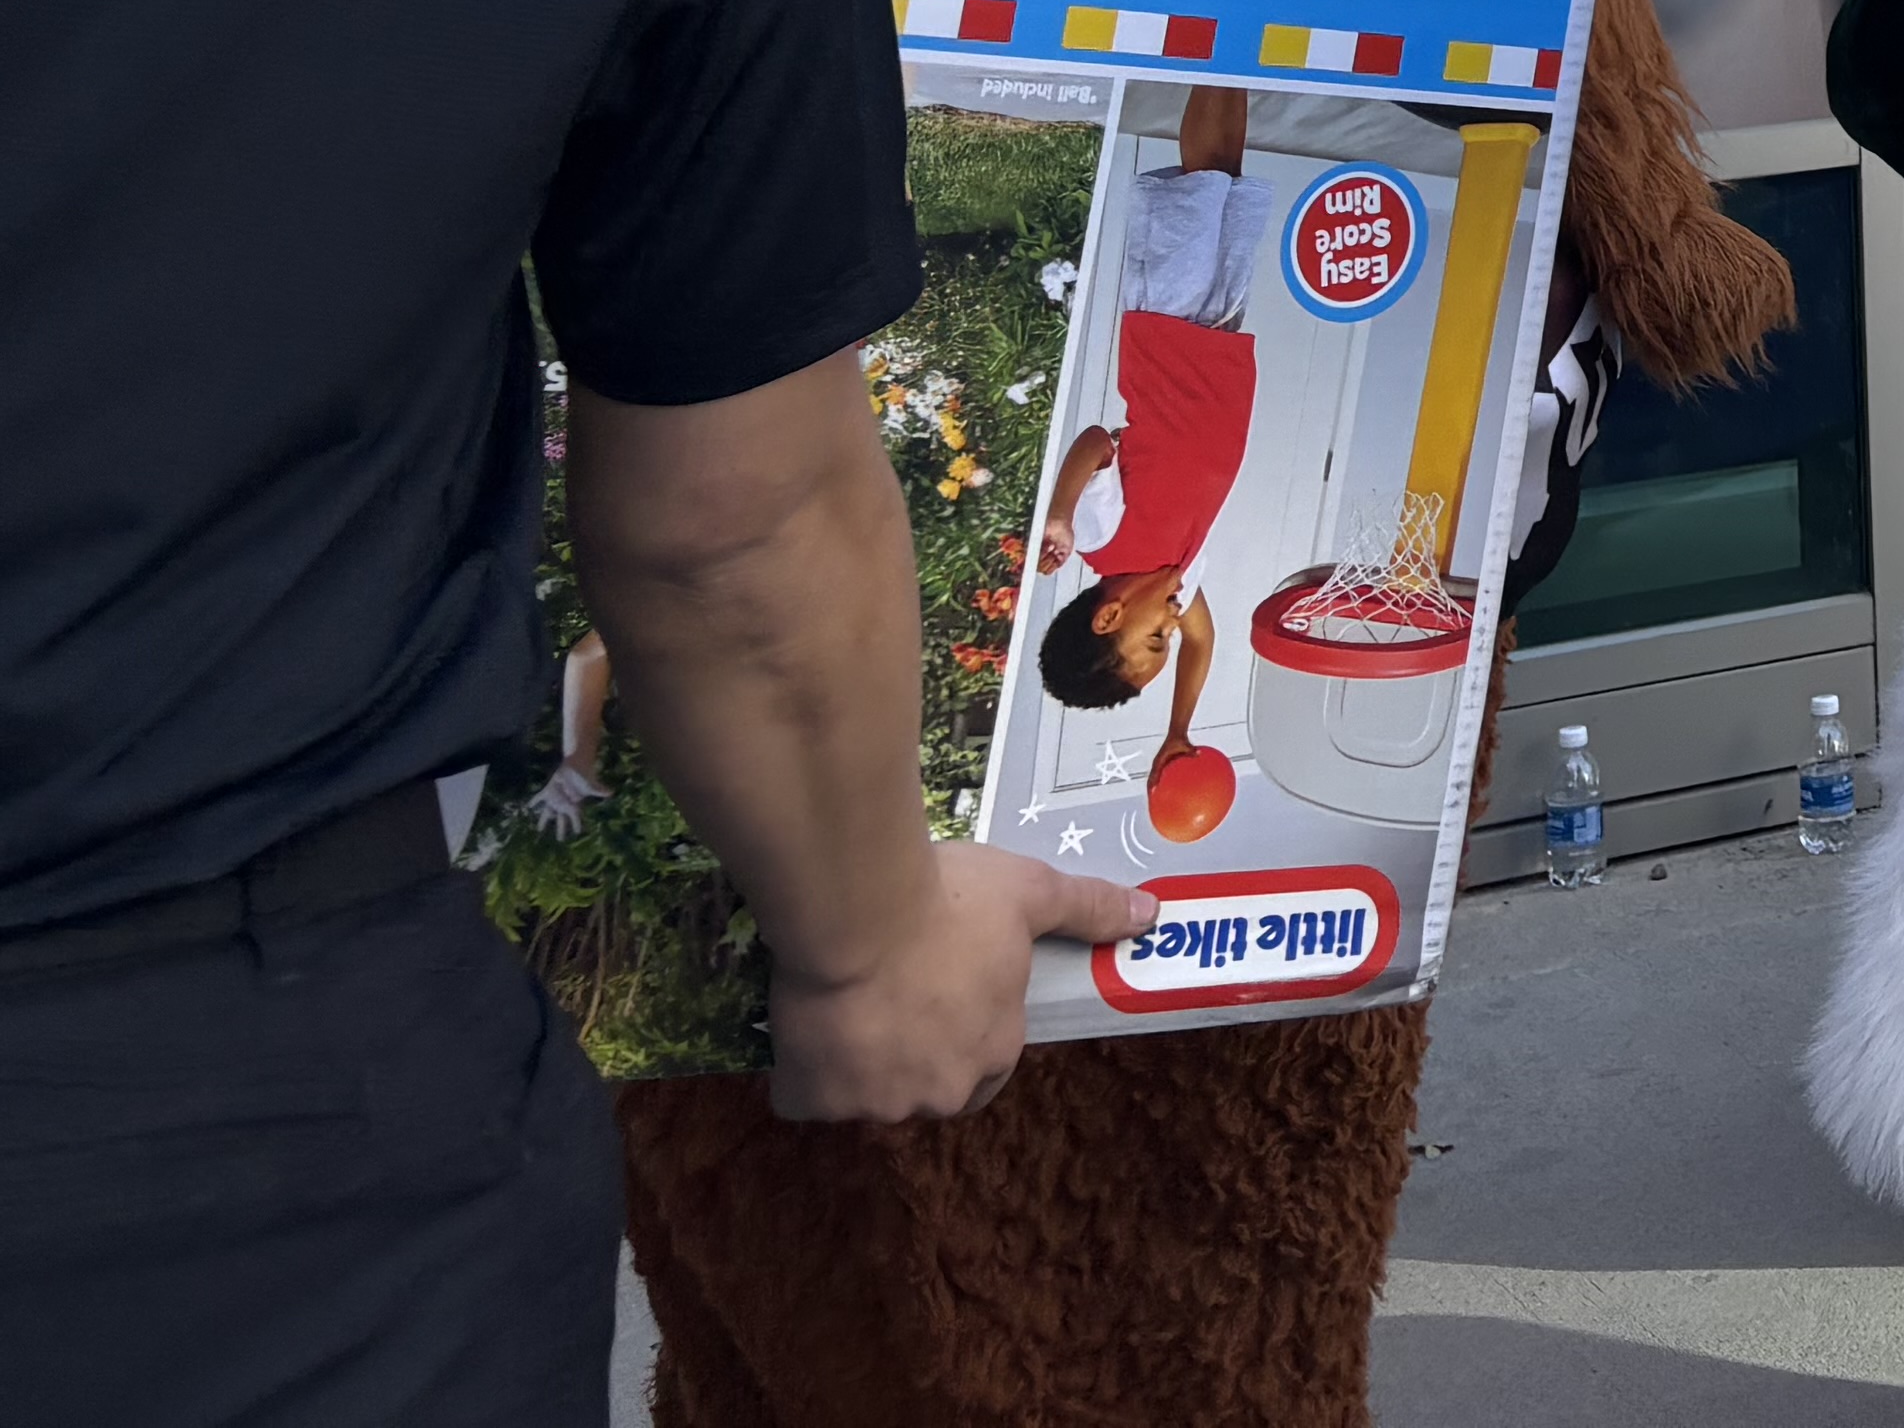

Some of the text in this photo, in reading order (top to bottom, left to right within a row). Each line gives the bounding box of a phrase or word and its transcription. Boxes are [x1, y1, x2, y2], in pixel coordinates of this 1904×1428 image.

[980, 79, 1053, 101] included
[1325, 184, 1382, 216] Rim
[1315, 218, 1392, 253] Score
[1320, 250, 1389, 288] Easy
[1130, 907, 1367, 969] little tikes
